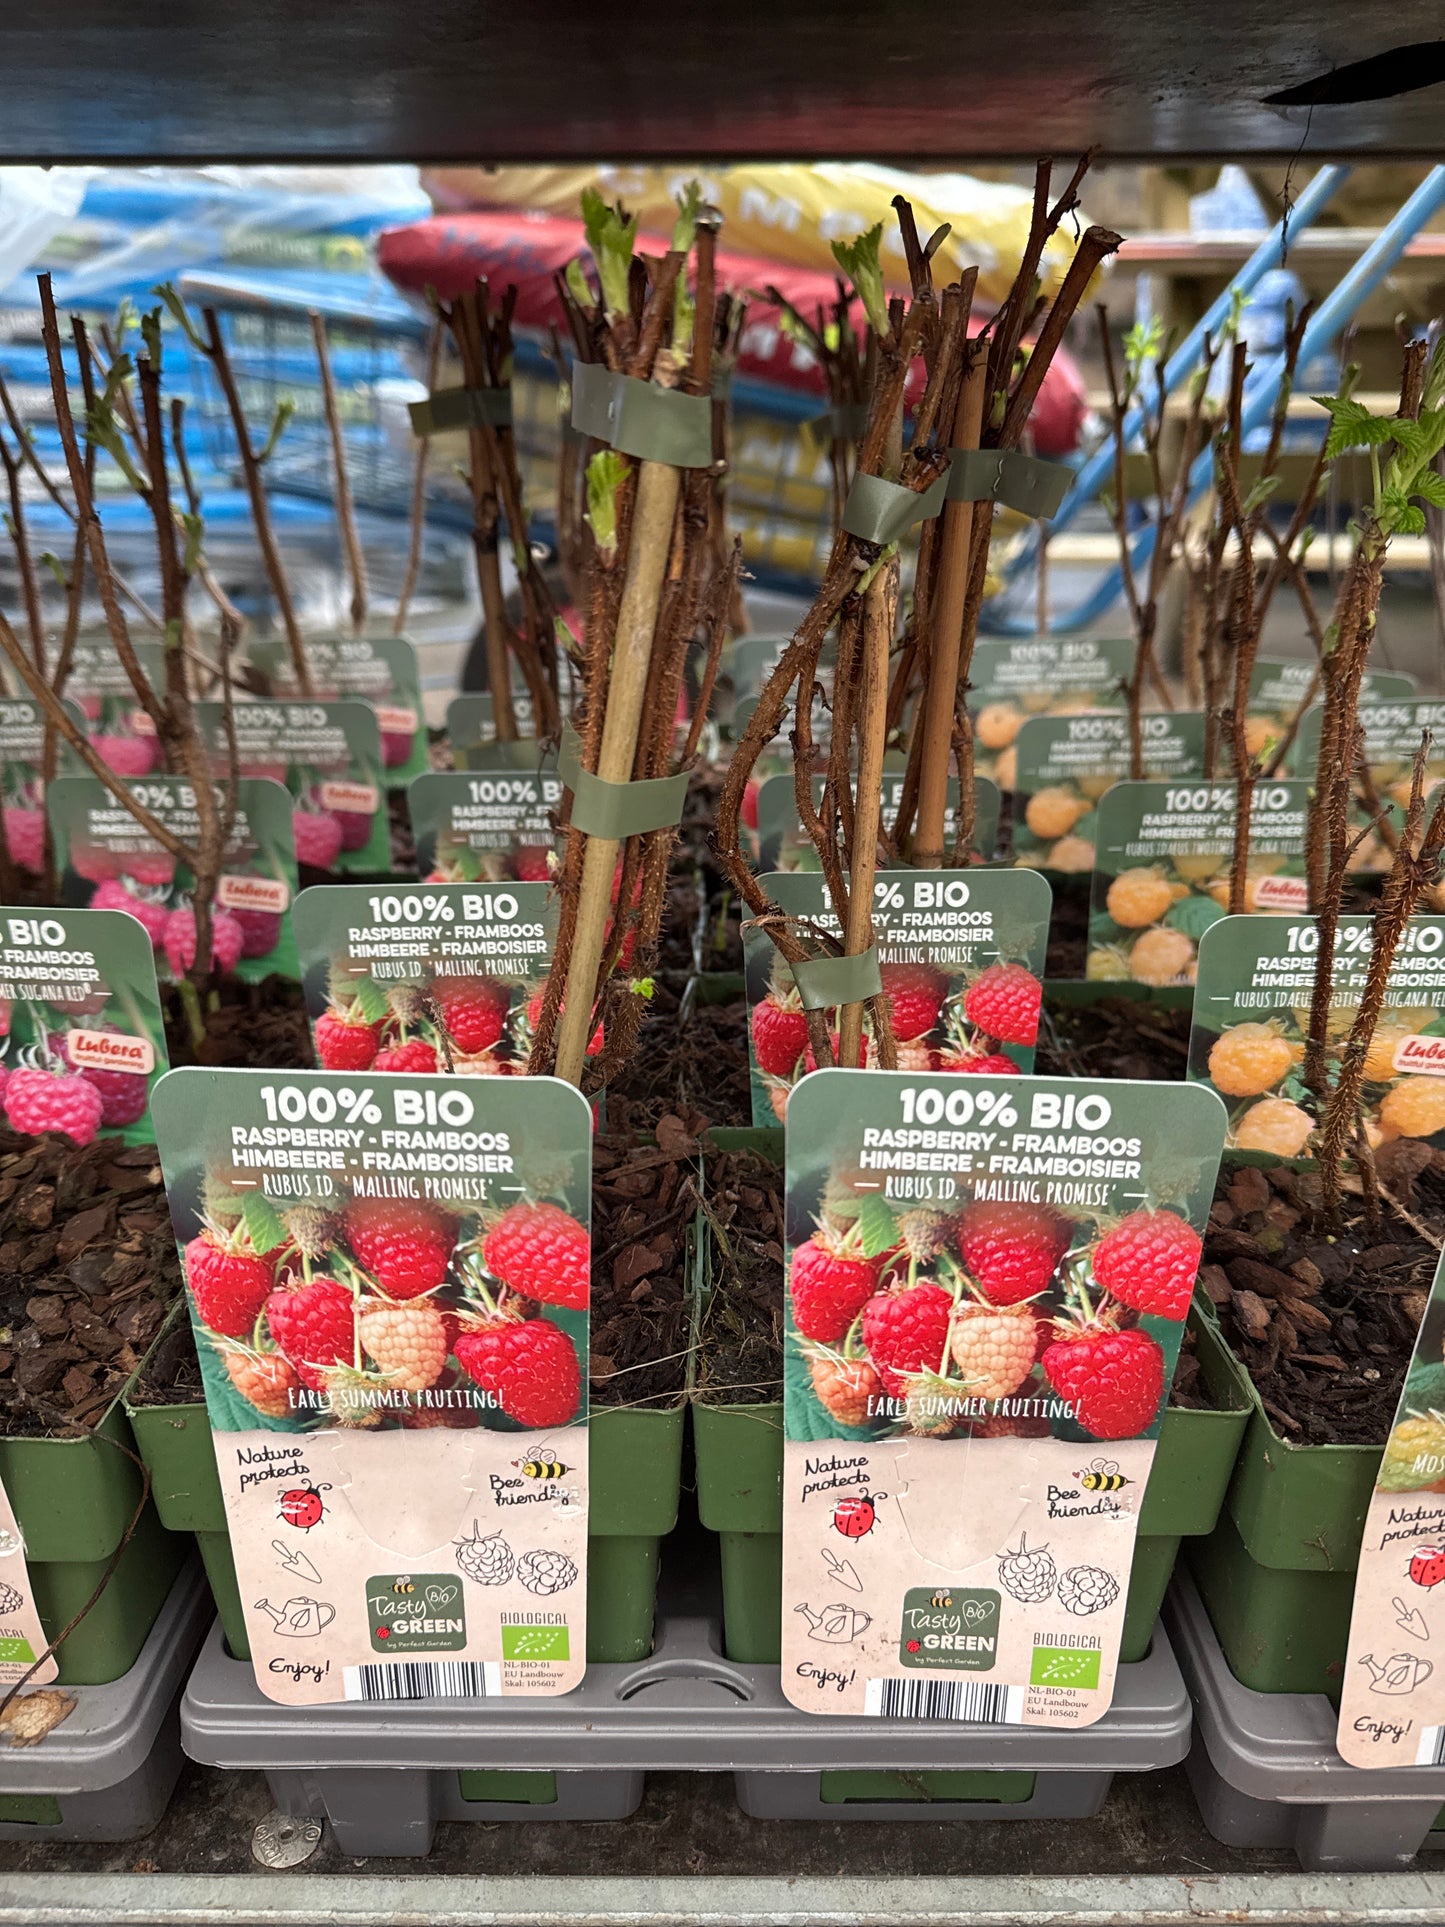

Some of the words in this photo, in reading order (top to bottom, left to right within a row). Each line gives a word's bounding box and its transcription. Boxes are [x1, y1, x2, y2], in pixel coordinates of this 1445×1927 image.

[1062, 641, 1099, 661] BIO
[287, 705, 328, 727] BIO
[1358, 704, 1411, 727] 00%
[1068, 718, 1125, 740] 100%
[104, 784, 175, 809] 10%
[469, 780, 538, 804] 100%
[1164, 787, 1236, 812] 100%
[1142, 813, 1220, 827] RASPBERRY
[1138, 826, 1206, 840] HIMBEERE
[913, 880, 971, 908] BIO
[368, 895, 455, 923] 100%
[462, 893, 519, 921] BIO
[902, 911, 993, 927] FRAMBOOS
[6, 918, 67, 947] BIO
[347, 925, 442, 942] RASPBERRY
[454, 923, 545, 940] FRAMBOOS
[887, 928, 994, 943] FRAMBOISIER
[4, 949, 96, 966] FRAMBOOS
[348, 941, 431, 959] HIMBEERE
[441, 939, 548, 957] FRAMBOISIER
[877, 946, 926, 965] MALLING
[370, 960, 406, 979] RUBUS
[408, 960, 427, 978] ID.
[18, 983, 65, 1001] SUGANA
[1233, 991, 1270, 1008] RUBUS
[1429, 991, 1445, 1008] YEL
[76, 1035, 144, 1059] Lubera
[1402, 1040, 1445, 1060] Lube
[260, 1085, 383, 1125] 100%
[393, 1088, 474, 1127] BIO
[899, 1087, 1019, 1128] 100%
[1030, 1092, 1112, 1132] BIO
[231, 1126, 365, 1148] RASPBERRY
[381, 1130, 511, 1152] FRAMBOOS
[863, 1127, 997, 1151] RASPBERRY
[1012, 1133, 1142, 1158] FRAMBOOS
[231, 1148, 345, 1170] HIMBEERE
[362, 1152, 514, 1174] FRAMBOISIER
[858, 1150, 973, 1173] HIMBEERE
[988, 1155, 1142, 1180] FRAMBOISIER
[262, 1174, 313, 1198] RUBUS
[316, 1176, 340, 1198] ID.
[344, 1176, 421, 1200] 'MALLING
[423, 1178, 494, 1201] PROMISE'
[884, 1176, 934, 1200] RUBUS
[936, 1178, 960, 1201] ID.
[966, 1179, 1042, 1205] 'MALLING
[1044, 1183, 1118, 1207] PROMISE'
[287, 1386, 335, 1410] EARLY
[340, 1388, 411, 1410] SUMMER
[416, 1387, 505, 1410] FRUITING!
[866, 1394, 912, 1422] EARLY
[918, 1395, 986, 1419] SUMMER
[992, 1397, 1083, 1421] FRUITING!
[236, 1444, 304, 1466] Nature
[804, 1454, 869, 1476] Nature
[1411, 1453, 1445, 1473] MOS
[239, 1459, 311, 1493] protects
[489, 1474, 525, 1490] Bee
[801, 1468, 871, 1503] protects
[1046, 1484, 1081, 1502] Bee
[1387, 1505, 1445, 1526] Natur
[1379, 1518, 1445, 1551] protect
[430, 1591, 450, 1604] BIO
[368, 1596, 427, 1621] Tasty
[500, 1612, 569, 1625] BIOLOGICAL
[966, 1606, 986, 1619] BIO
[391, 1618, 463, 1634] GREEN
[904, 1608, 961, 1636] Tasty
[386, 1641, 397, 1649] by
[923, 1634, 995, 1652] GREEN
[1032, 1632, 1102, 1649] BIOLOGICAL
[268, 1657, 331, 1684] Enjoy!
[503, 1661, 551, 1669] NL-BIO-01
[954, 1658, 980, 1666] Garden
[504, 1670, 518, 1678] EU
[520, 1670, 565, 1679] Landbouw
[504, 1679, 525, 1688] Skal:
[527, 1680, 556, 1688] 105602
[796, 1661, 858, 1693] Enjoy!
[1028, 1686, 1077, 1697] NL-BIO-01
[1026, 1706, 1047, 1716] Skal:
[1048, 1708, 1079, 1718] 105602
[1027, 1696, 1042, 1705] EU
[1043, 1697, 1089, 1709] Landbouw
[1353, 1715, 1413, 1744] Enjoy!
